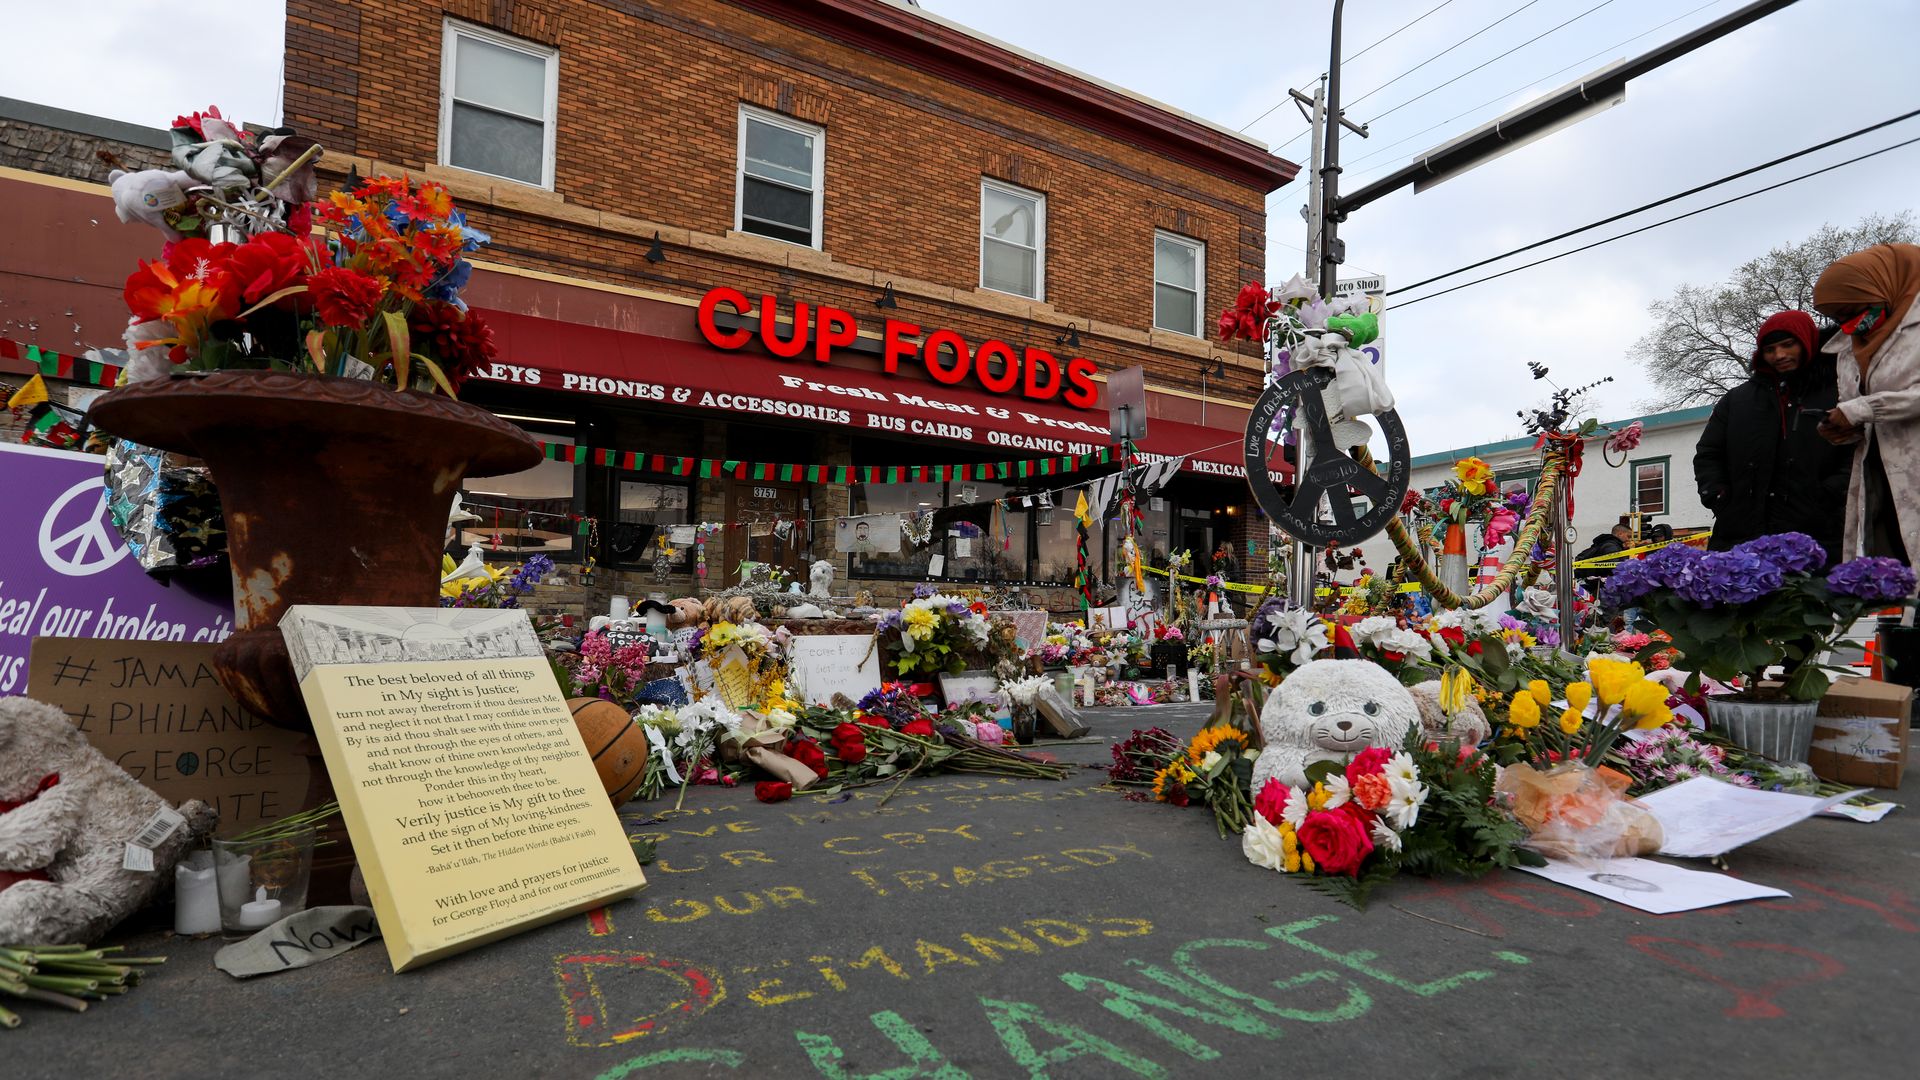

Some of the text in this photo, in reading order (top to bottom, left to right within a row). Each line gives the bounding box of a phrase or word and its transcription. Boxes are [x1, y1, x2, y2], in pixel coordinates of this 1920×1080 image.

[1357, 279, 1380, 291] Shop
[698, 286, 1099, 409] CUP FOODS
[562, 372, 665, 400] PHONES
[671, 387, 692, 402] &
[699, 391, 851, 424] ACCESSORIES
[867, 413, 907, 432] BUS
[910, 420, 973, 440] CARDS
[987, 431, 1064, 453] ORGANIC
[778, 374, 1112, 436] Fresh Meat & Produ
[1247, 436, 1260, 457] Love
[1255, 416, 1267, 433] one
[754, 487, 776, 498] 3757
[0, 587, 234, 644] eal our broken cit
[607, 631, 657, 643] George
[110, 656, 219, 688] JAMA
[344, 669, 535, 687] The best beloved of all things
[336, 710, 363, 719] turn
[365, 708, 386, 717] not
[388, 706, 418, 716] away
[420, 702, 472, 713] therefrom
[474, 700, 481, 708] if
[483, 699, 506, 708] thou
[507, 696, 542, 706] desirest
[380, 684, 519, 703] in My sight is Justice;
[343, 722, 366, 733] and
[369, 719, 411, 731] neglect
[413, 718, 421, 726] it
[423, 716, 441, 725] not
[443, 713, 464, 724] that
[466, 713, 471, 721] I
[472, 712, 494, 721] may
[496, 708, 530, 719] confide
[531, 707, 541, 715] in
[346, 717, 569, 749] By its aid thou shalt see with thine own eyes
[367, 727, 564, 758] and not through the eyes of others, and
[368, 738, 570, 772] shalt know of thine own knowledge and
[362, 749, 583, 788] not through the knowledge of thy neighbor.
[424, 767, 547, 793] Ponder this in thy heart,
[396, 786, 586, 829] Verily justice is My gift to thee
[418, 777, 561, 808] how it behooveth thee to be.
[401, 801, 593, 846] and the sign of My loving-kindness.
[430, 817, 581, 856] Set it then before thine eyes.
[822, 824, 982, 856] CRY
[481, 852, 497, 862] The
[498, 845, 525, 858] Hidden
[526, 839, 549, 851] Words
[575, 828, 596, 840] Faith)
[432, 866, 621, 926] for George Floyd and for our communities
[435, 856, 609, 909] With love and prayers for justice
